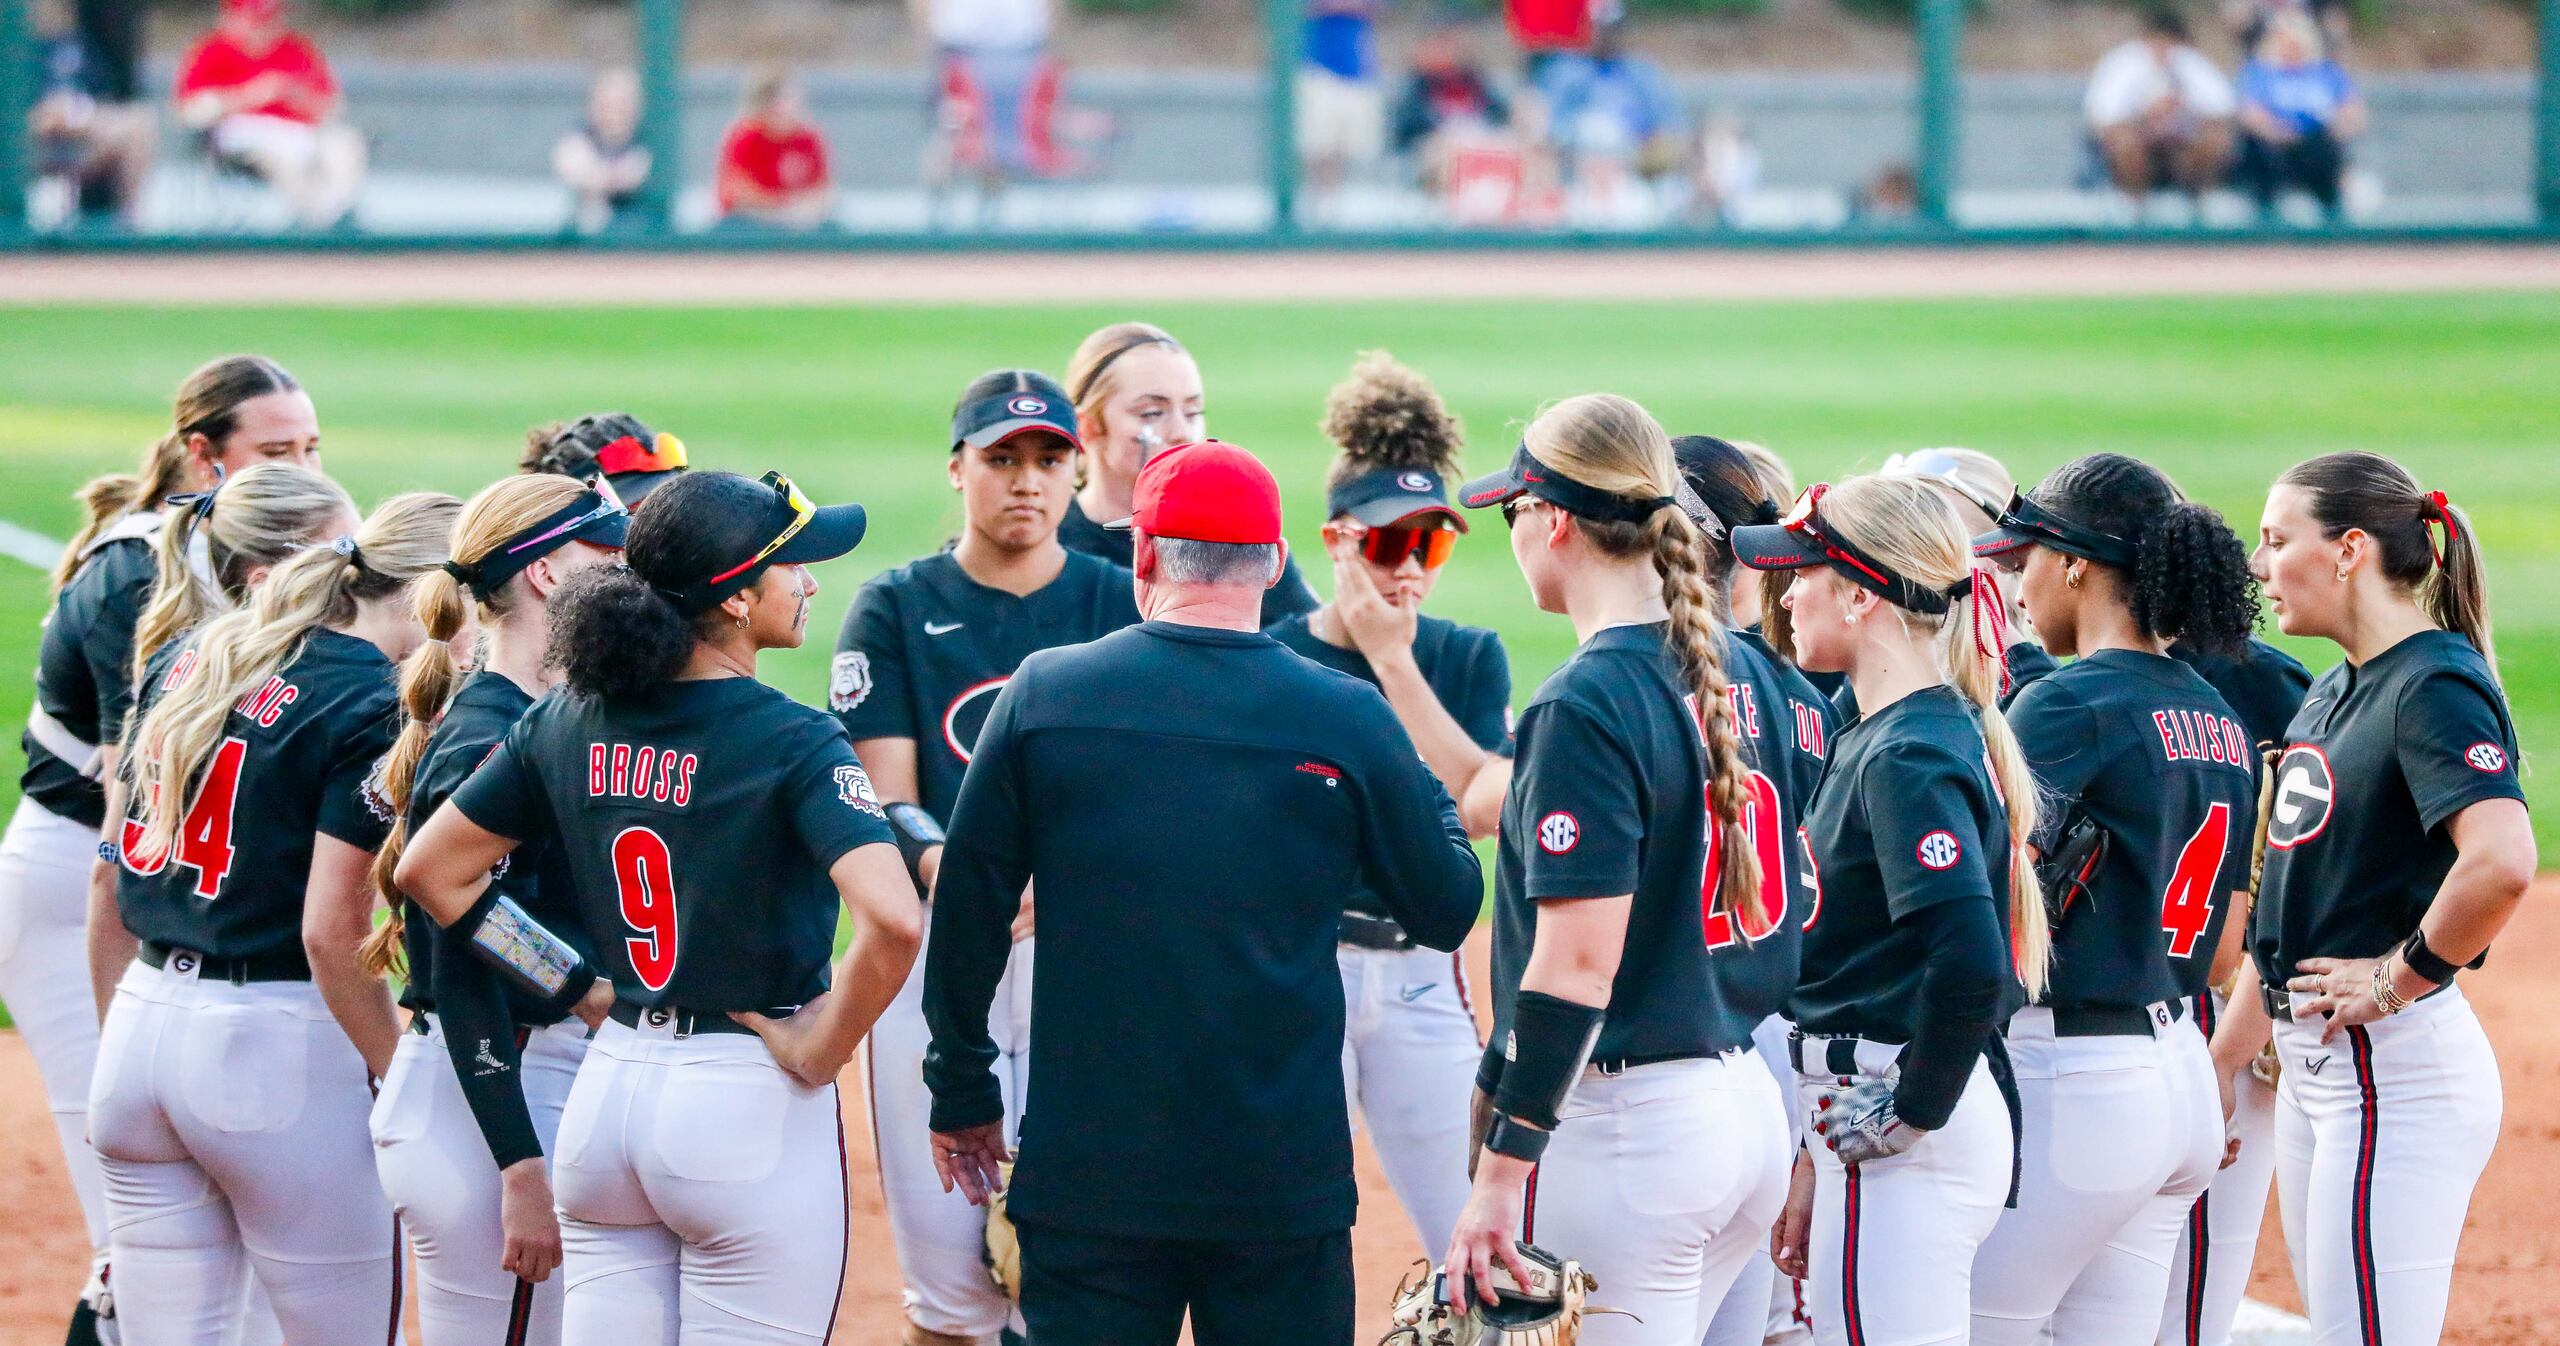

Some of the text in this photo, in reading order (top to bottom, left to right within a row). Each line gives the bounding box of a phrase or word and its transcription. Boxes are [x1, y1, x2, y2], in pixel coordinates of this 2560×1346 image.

[1754, 554, 1802, 566] SOFTBALL
[2153, 710, 2251, 775] ELLISON
[2467, 743, 2504, 771] SEC
[589, 743, 698, 807] BROSS
[2273, 762, 2332, 829] G
[1540, 813, 1577, 852] SEC
[1919, 832, 1958, 868] SEC
[2162, 801, 2230, 959] 4
[611, 826, 678, 992] 9
[474, 1065, 510, 1077] MUELER
